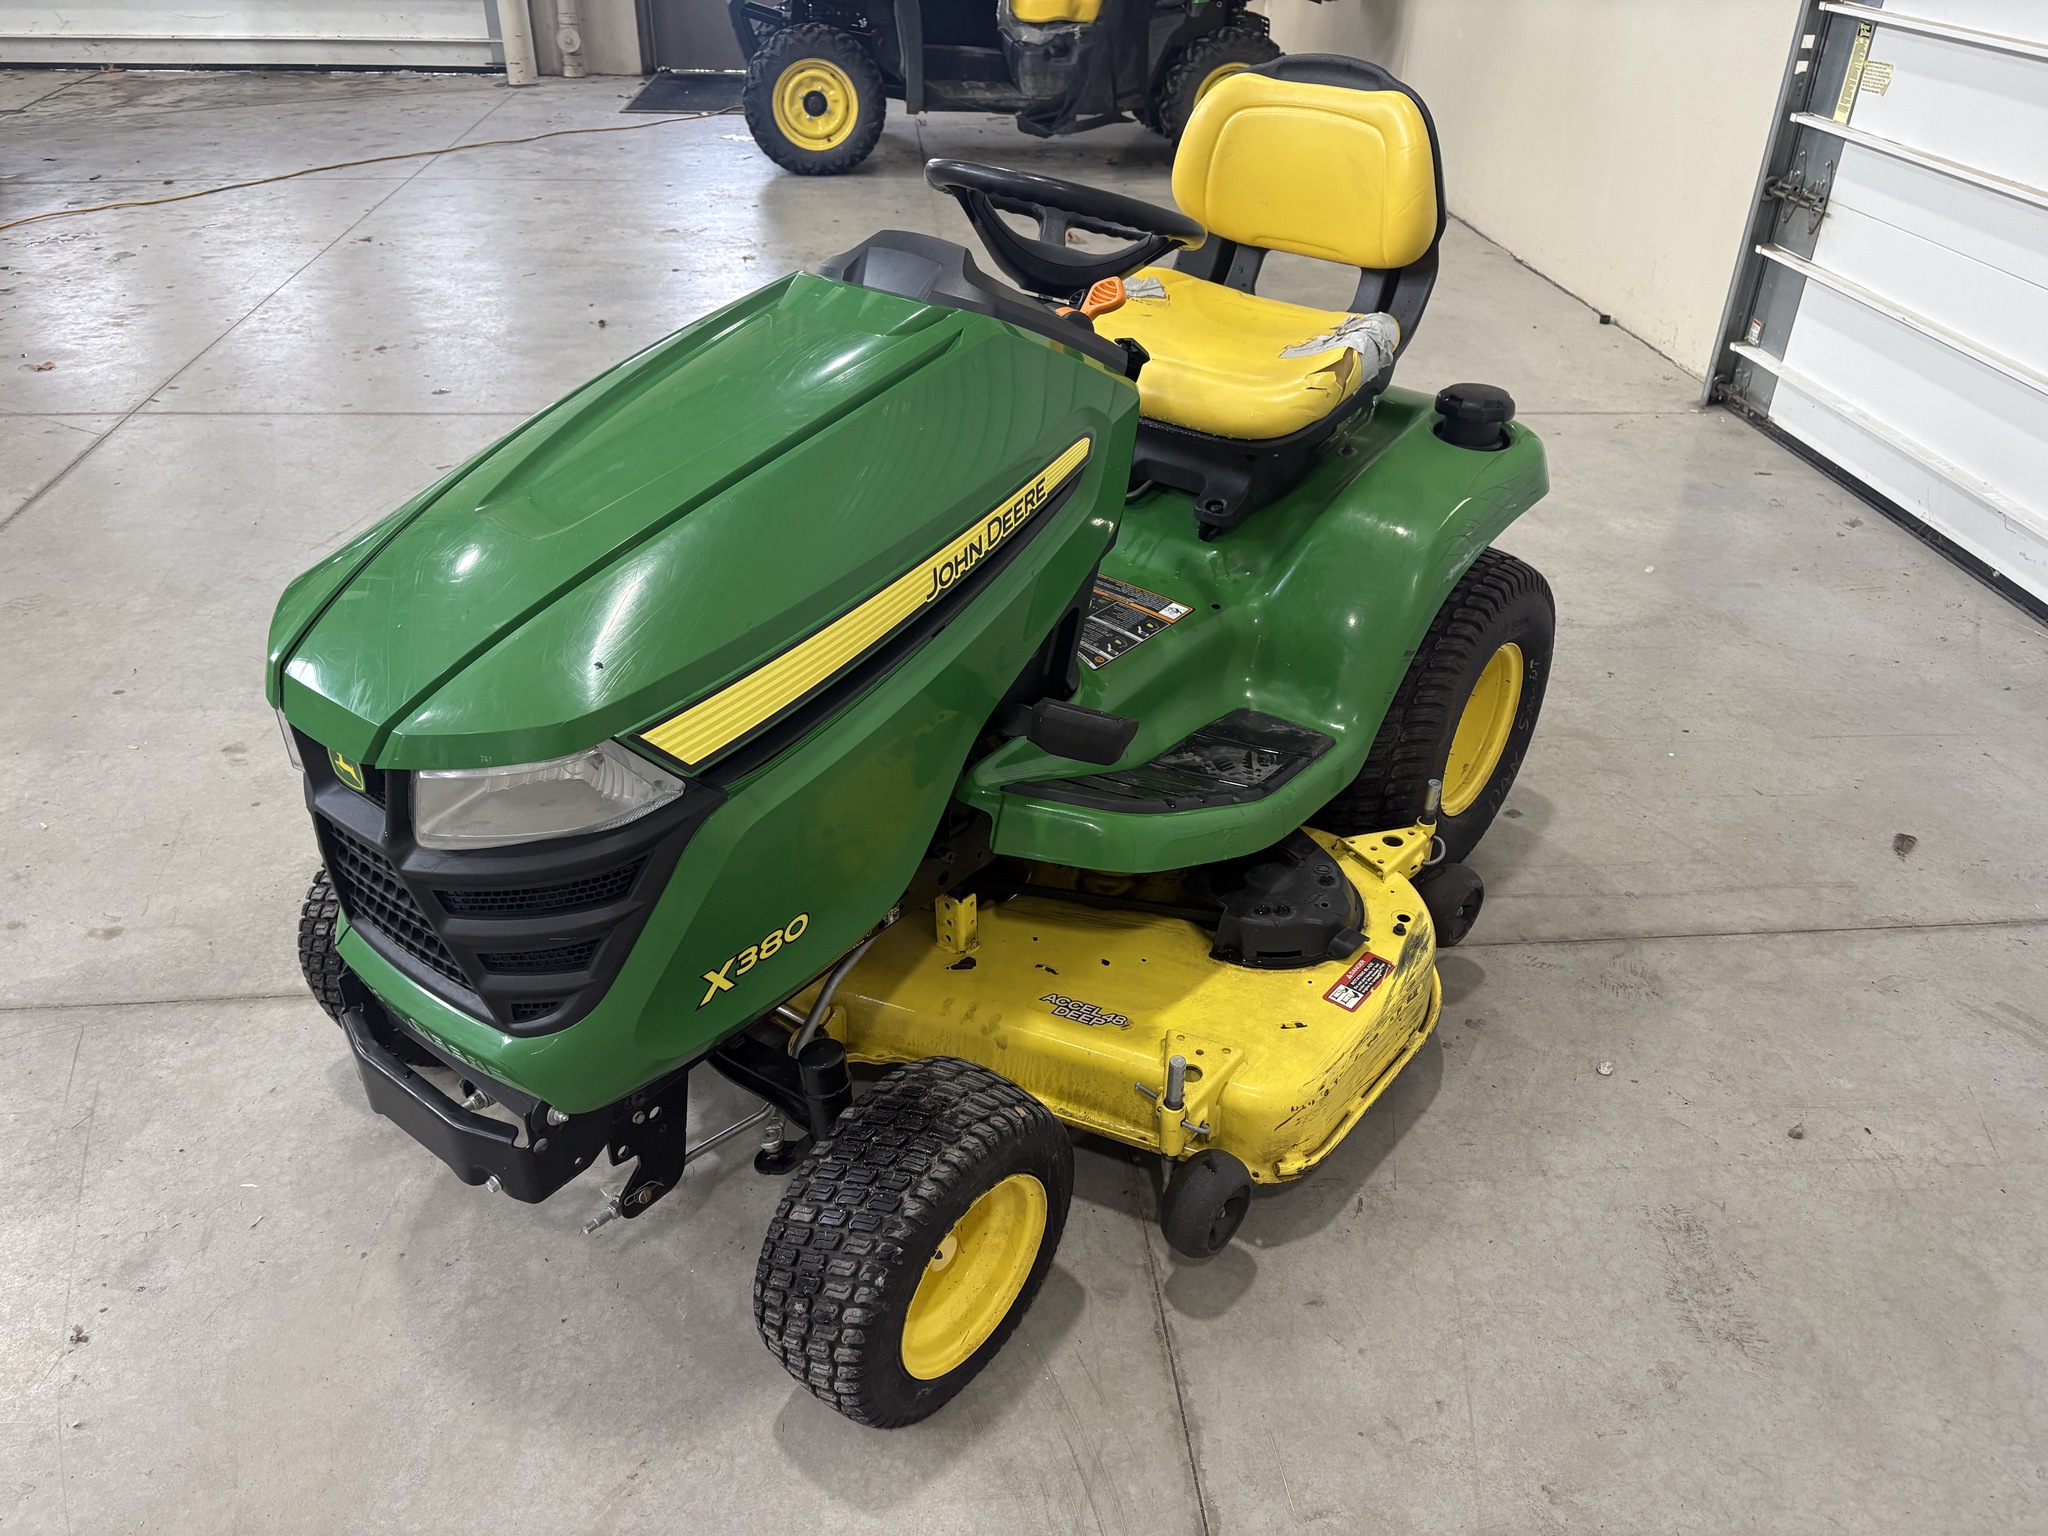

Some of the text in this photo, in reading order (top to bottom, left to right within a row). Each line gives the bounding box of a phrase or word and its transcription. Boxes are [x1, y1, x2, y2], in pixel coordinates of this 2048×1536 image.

[926, 476, 1048, 602] JOHN DEERE
[696, 912, 809, 1010] X380
[1350, 959, 1366, 977] DANGER
[1040, 993, 1102, 1018] ACCEL
[1051, 1005, 1107, 1026] DEEP
